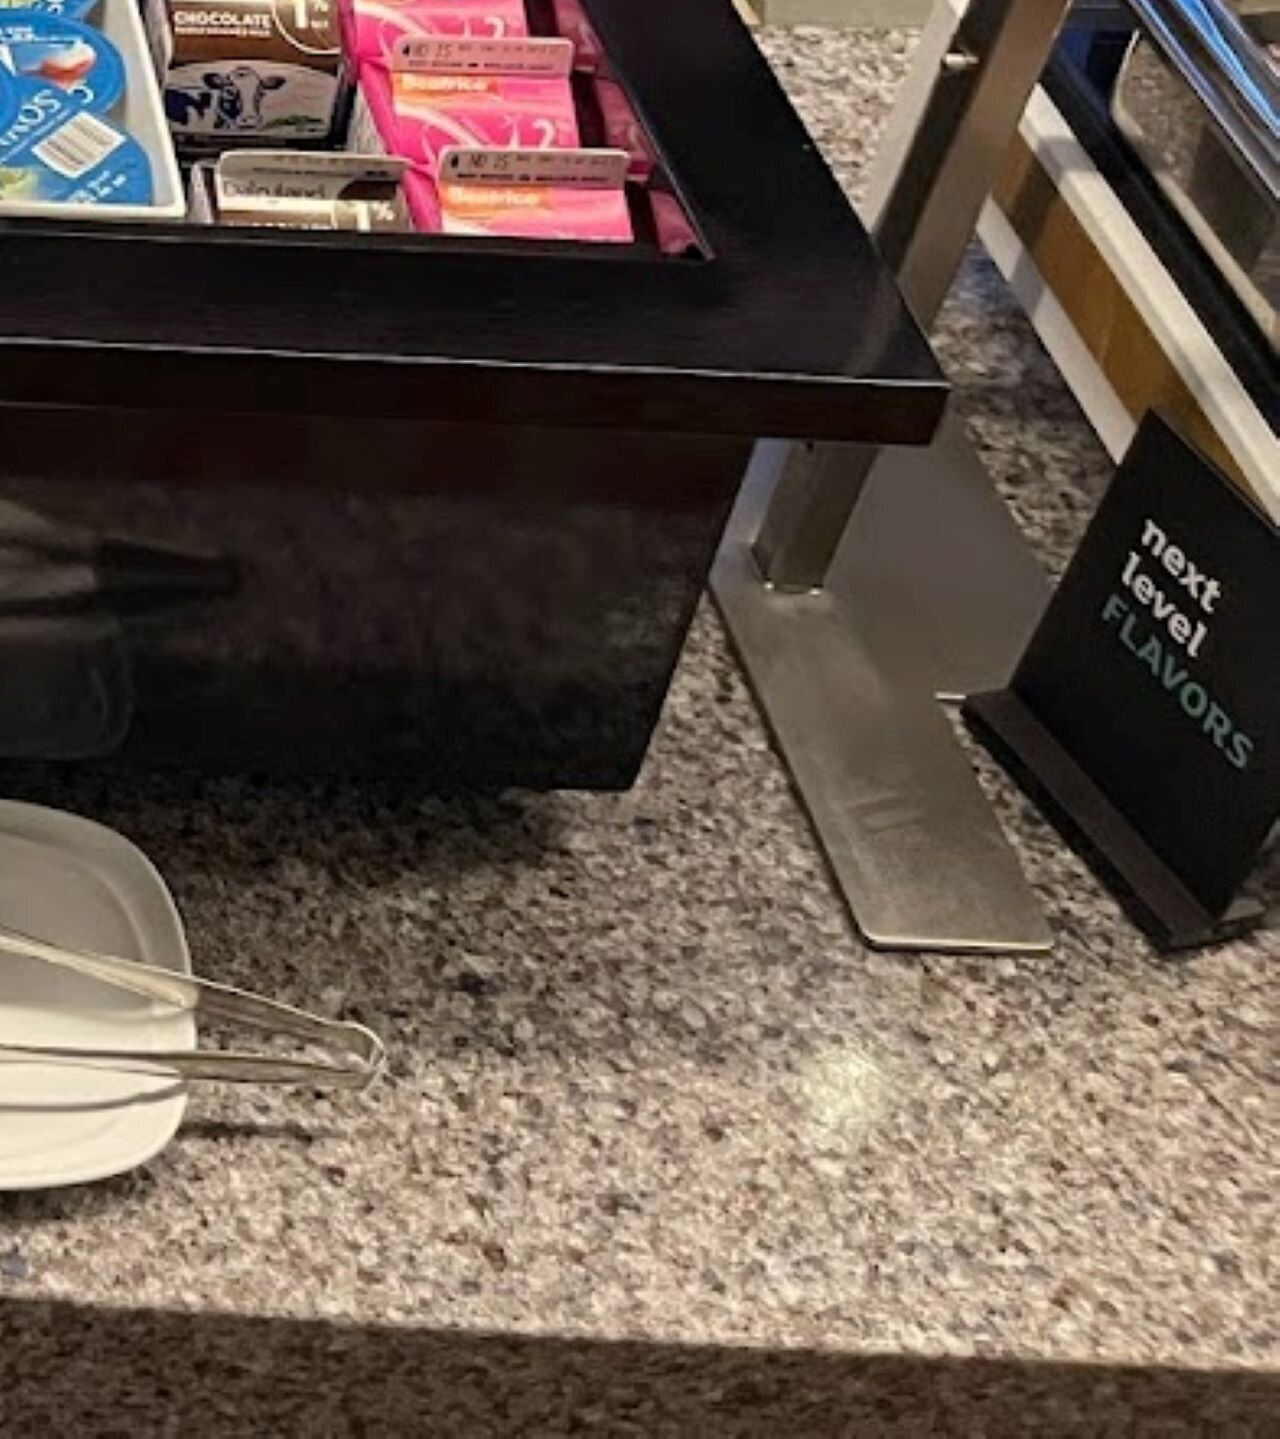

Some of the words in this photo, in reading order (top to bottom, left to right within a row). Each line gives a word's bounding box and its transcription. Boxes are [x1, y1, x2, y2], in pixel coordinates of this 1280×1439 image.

[173, 10, 272, 30] CHOCOLATE
[1121, 550, 1209, 659] level
[1141, 518, 1222, 615] next
[1101, 593, 1255, 770] FLAVORS
